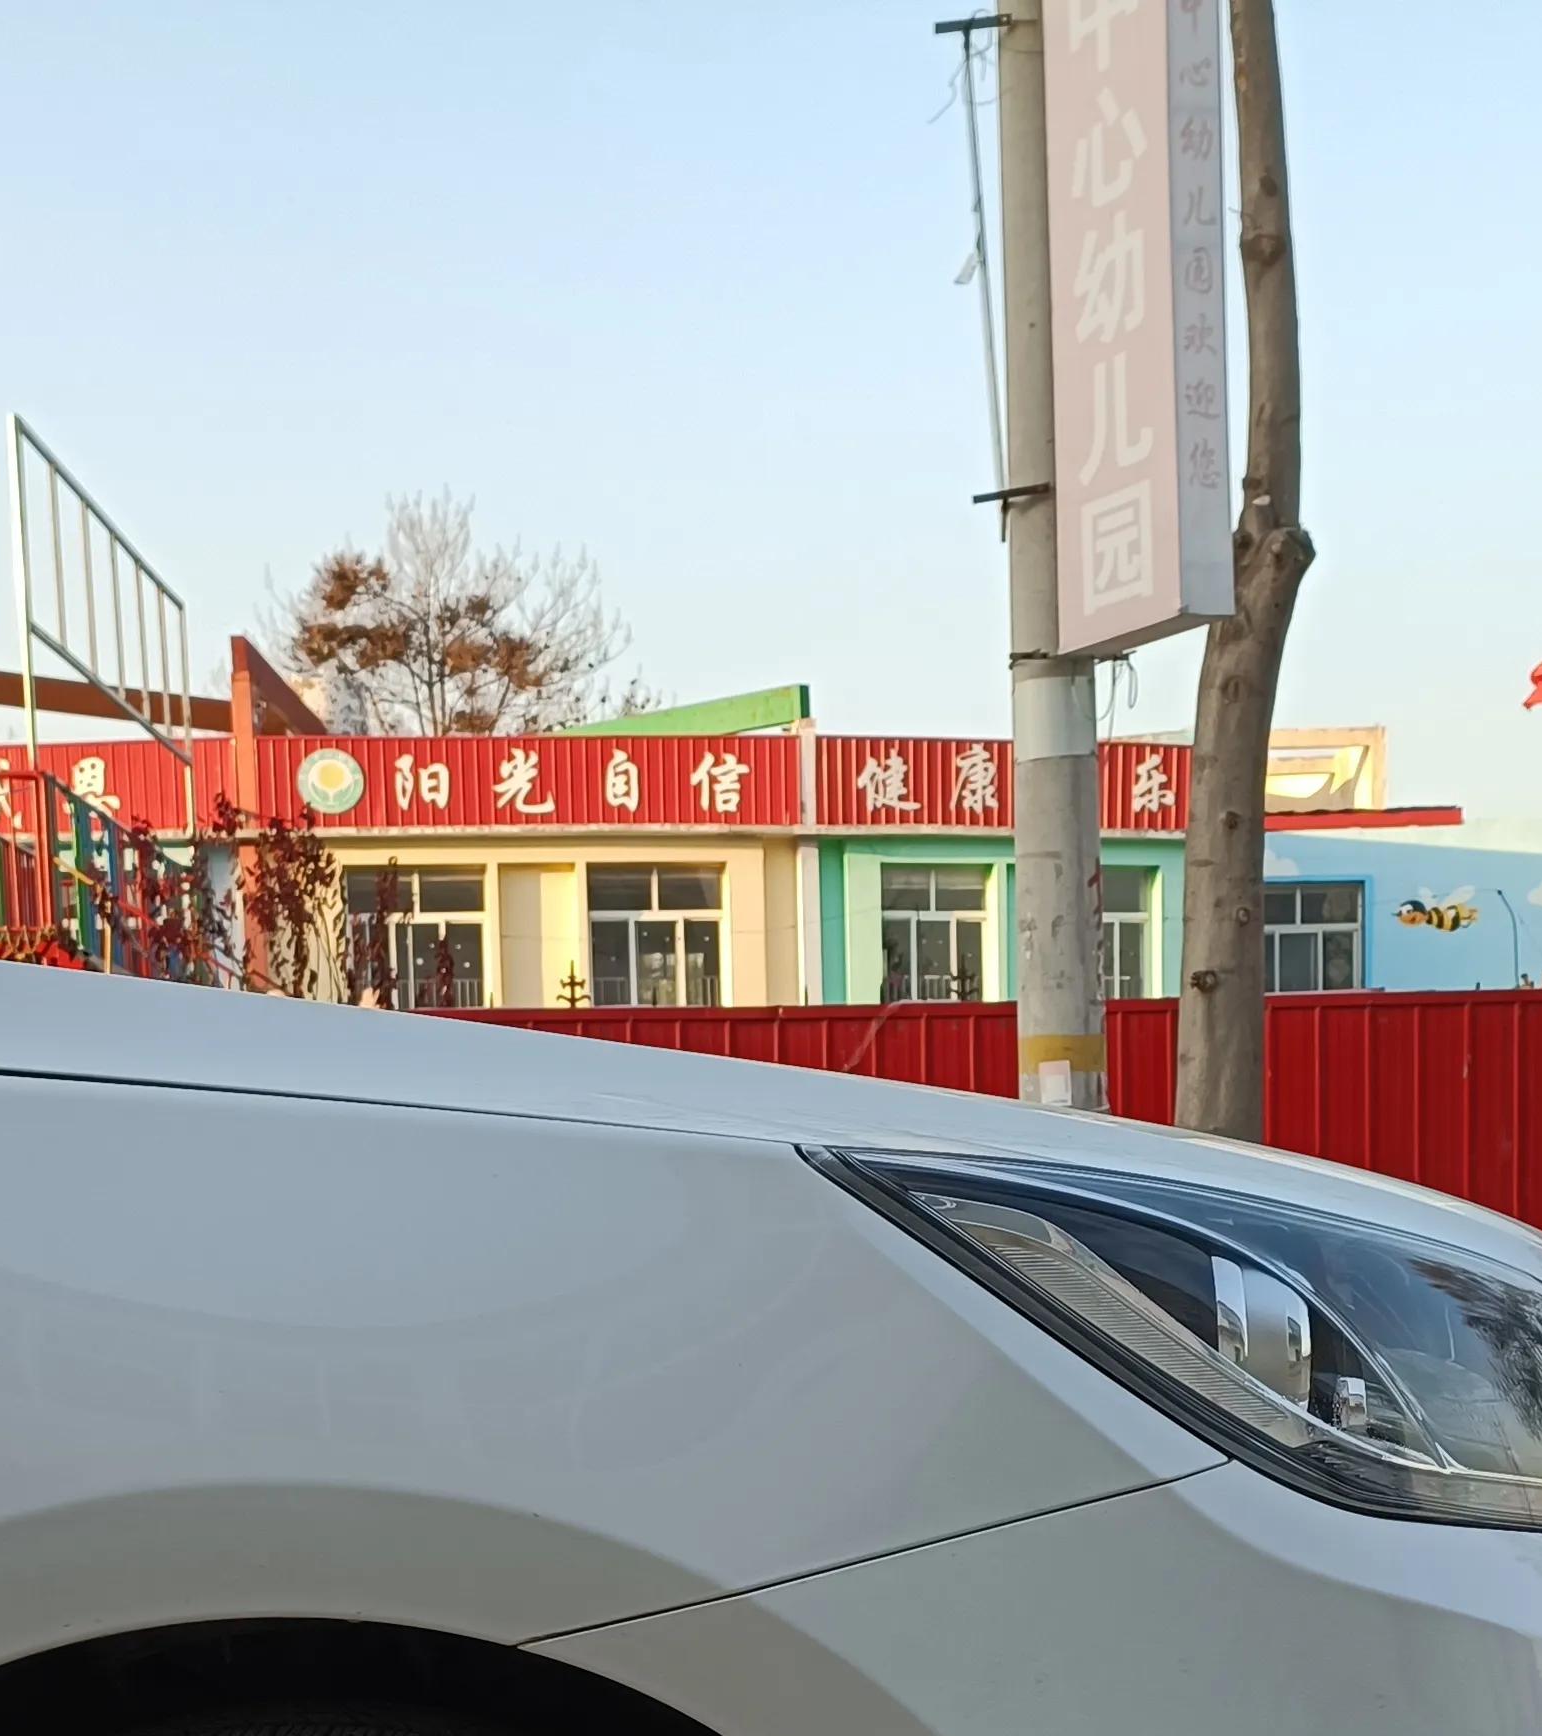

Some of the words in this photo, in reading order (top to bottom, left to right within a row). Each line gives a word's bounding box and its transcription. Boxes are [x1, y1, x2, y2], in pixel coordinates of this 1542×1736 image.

[393, 747, 750, 814] 阳光自信
[857, 742, 1177, 814] 健康乐
